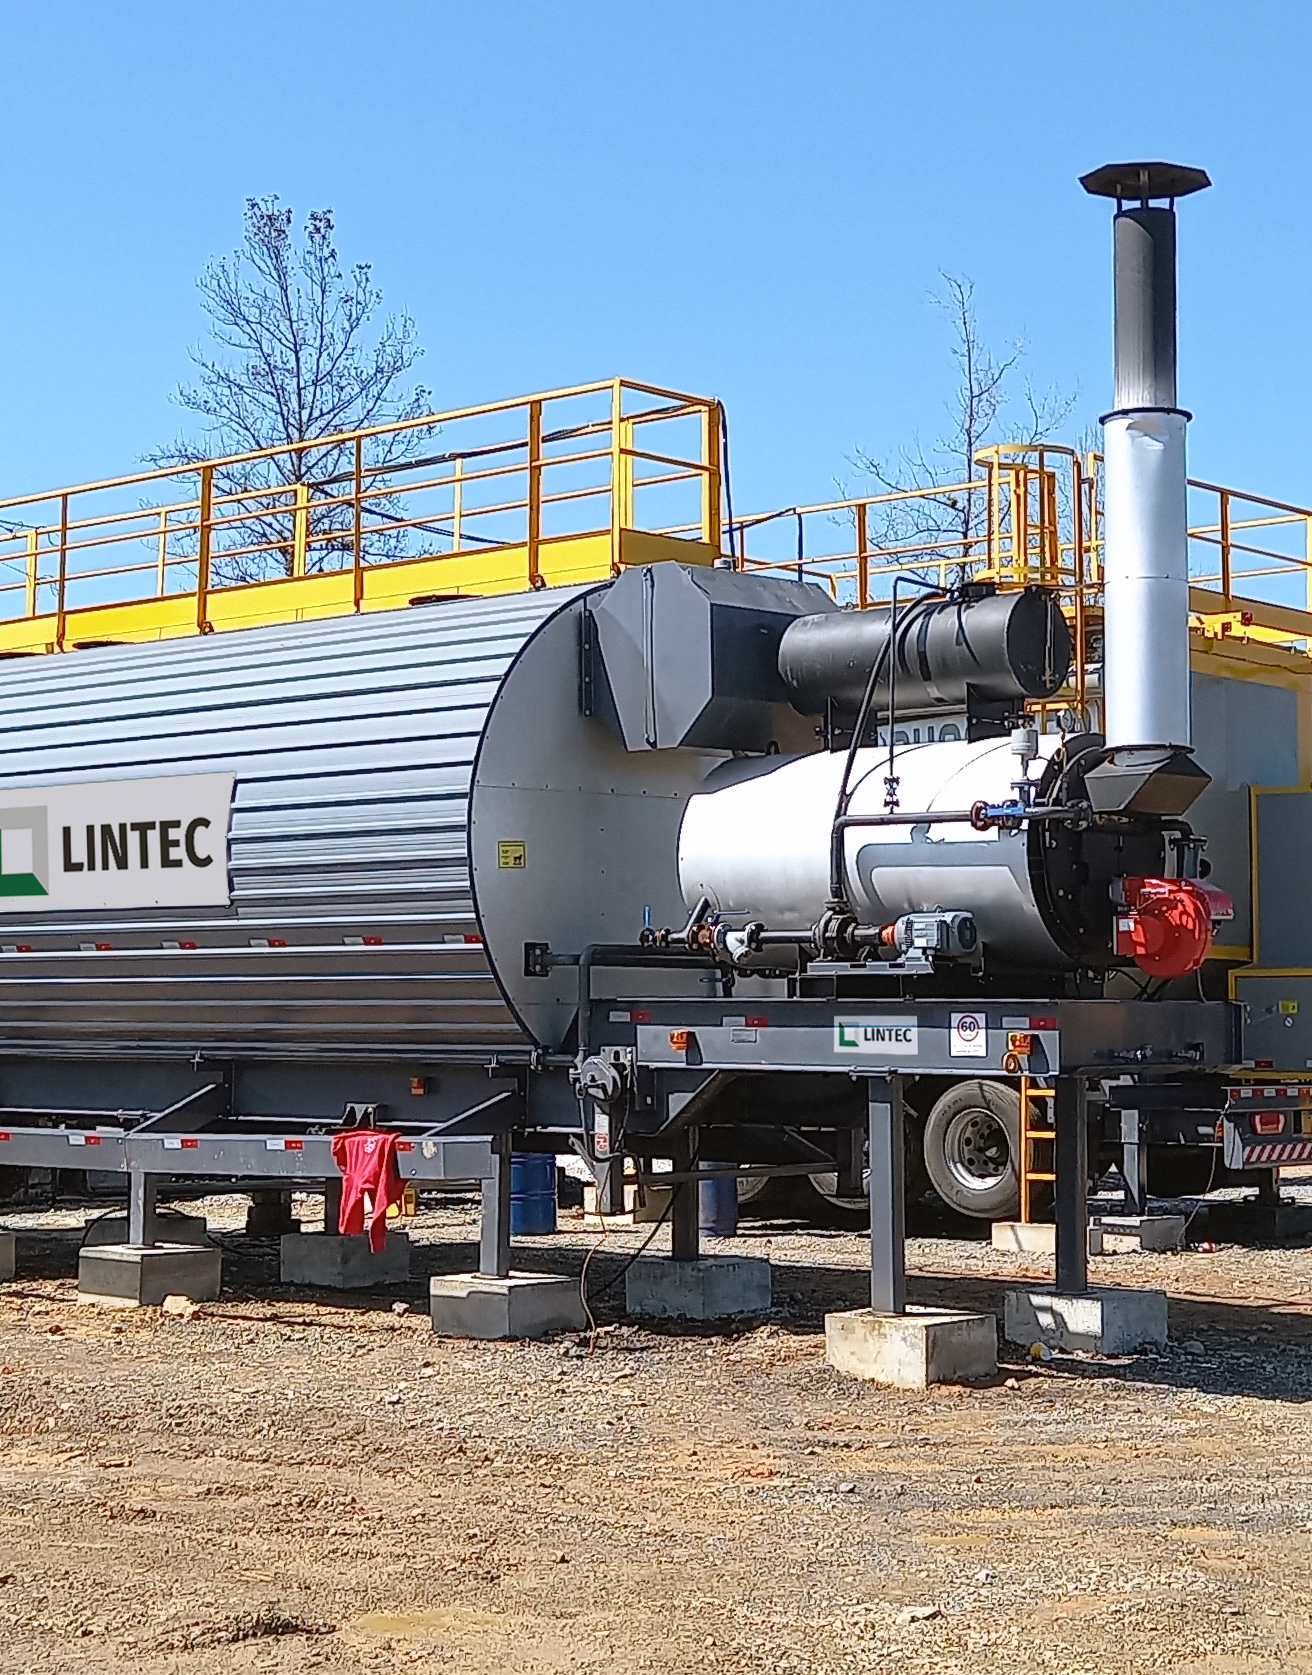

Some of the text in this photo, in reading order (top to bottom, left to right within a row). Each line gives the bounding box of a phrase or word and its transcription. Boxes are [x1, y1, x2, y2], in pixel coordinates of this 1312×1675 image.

[62, 817, 214, 873] LINTEC
[960, 1021, 976, 1032] 60
[863, 1028, 913, 1043] LINTEC
